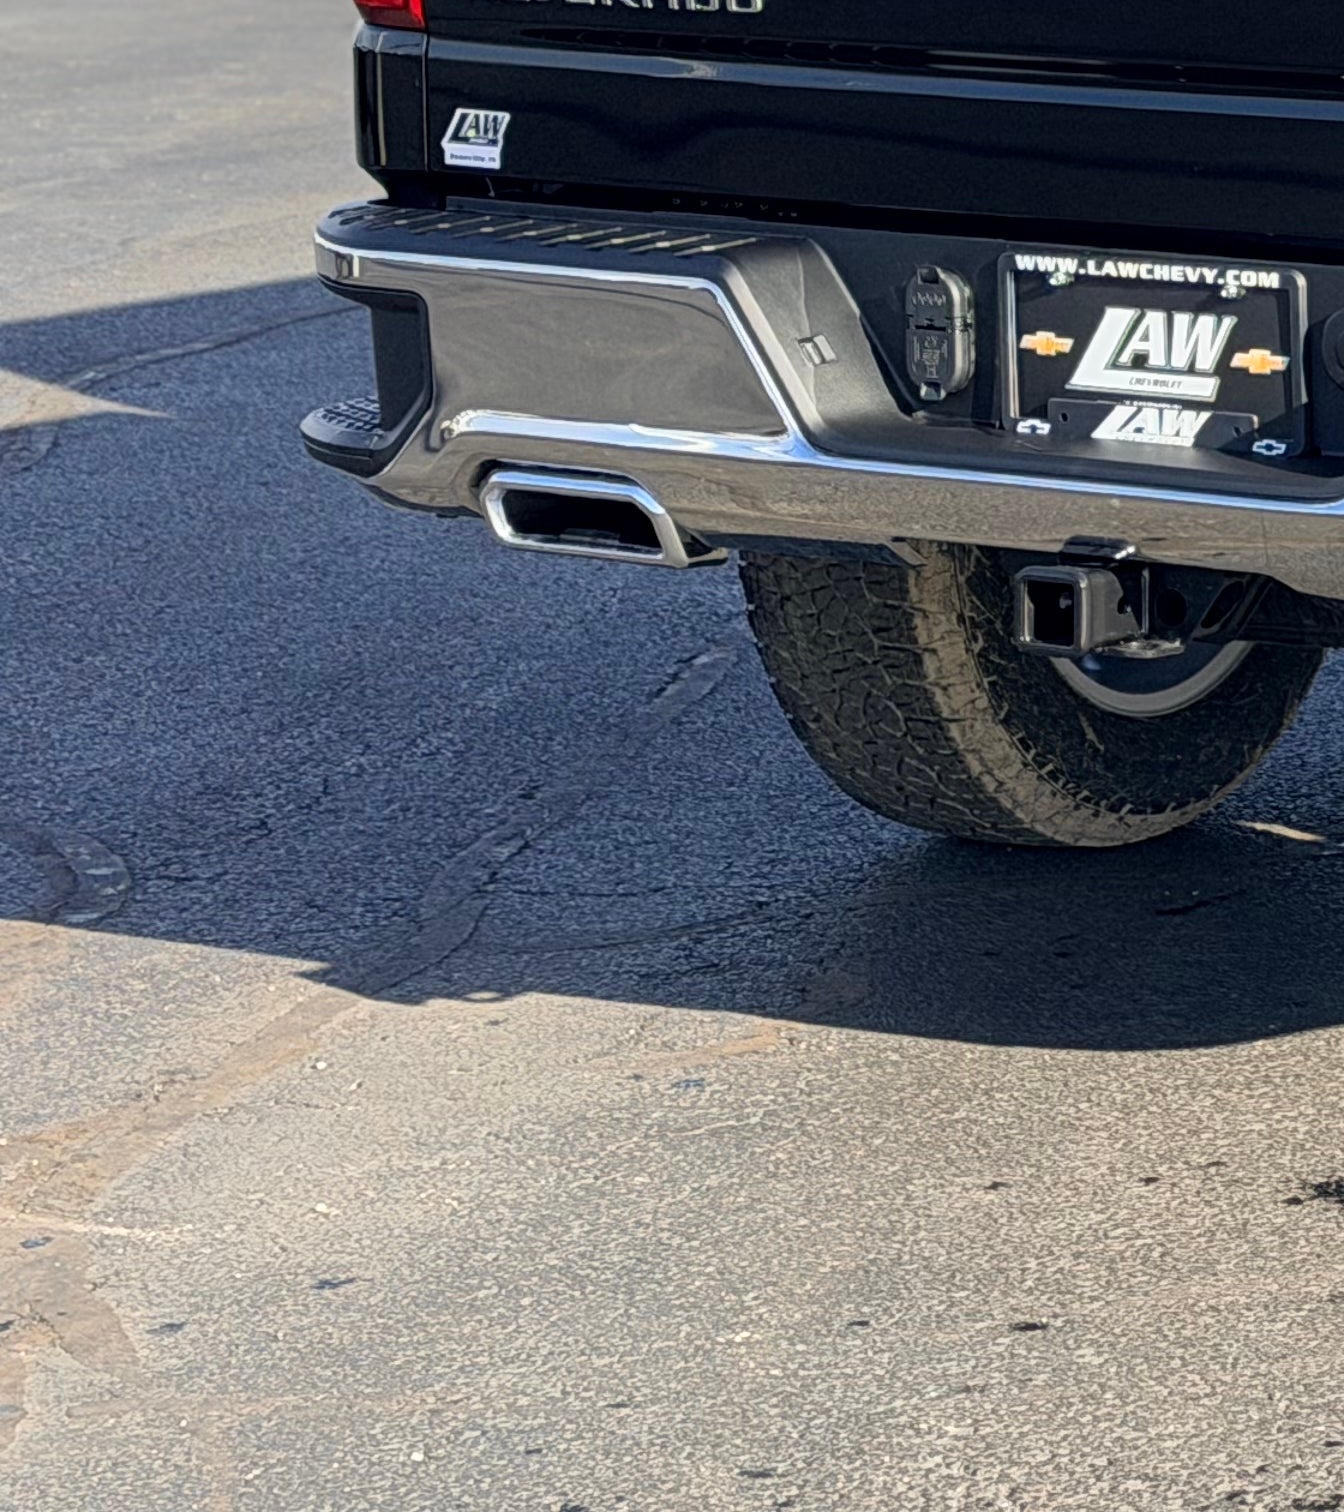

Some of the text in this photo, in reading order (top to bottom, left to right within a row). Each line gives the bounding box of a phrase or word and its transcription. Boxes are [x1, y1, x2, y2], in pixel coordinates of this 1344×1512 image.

[446, 111, 507, 148] LAW
[1014, 254, 1280, 289] WWW.LAWCHEVY.COM
[1064, 306, 1239, 403] LAW
[1090, 404, 1213, 448] LAW
